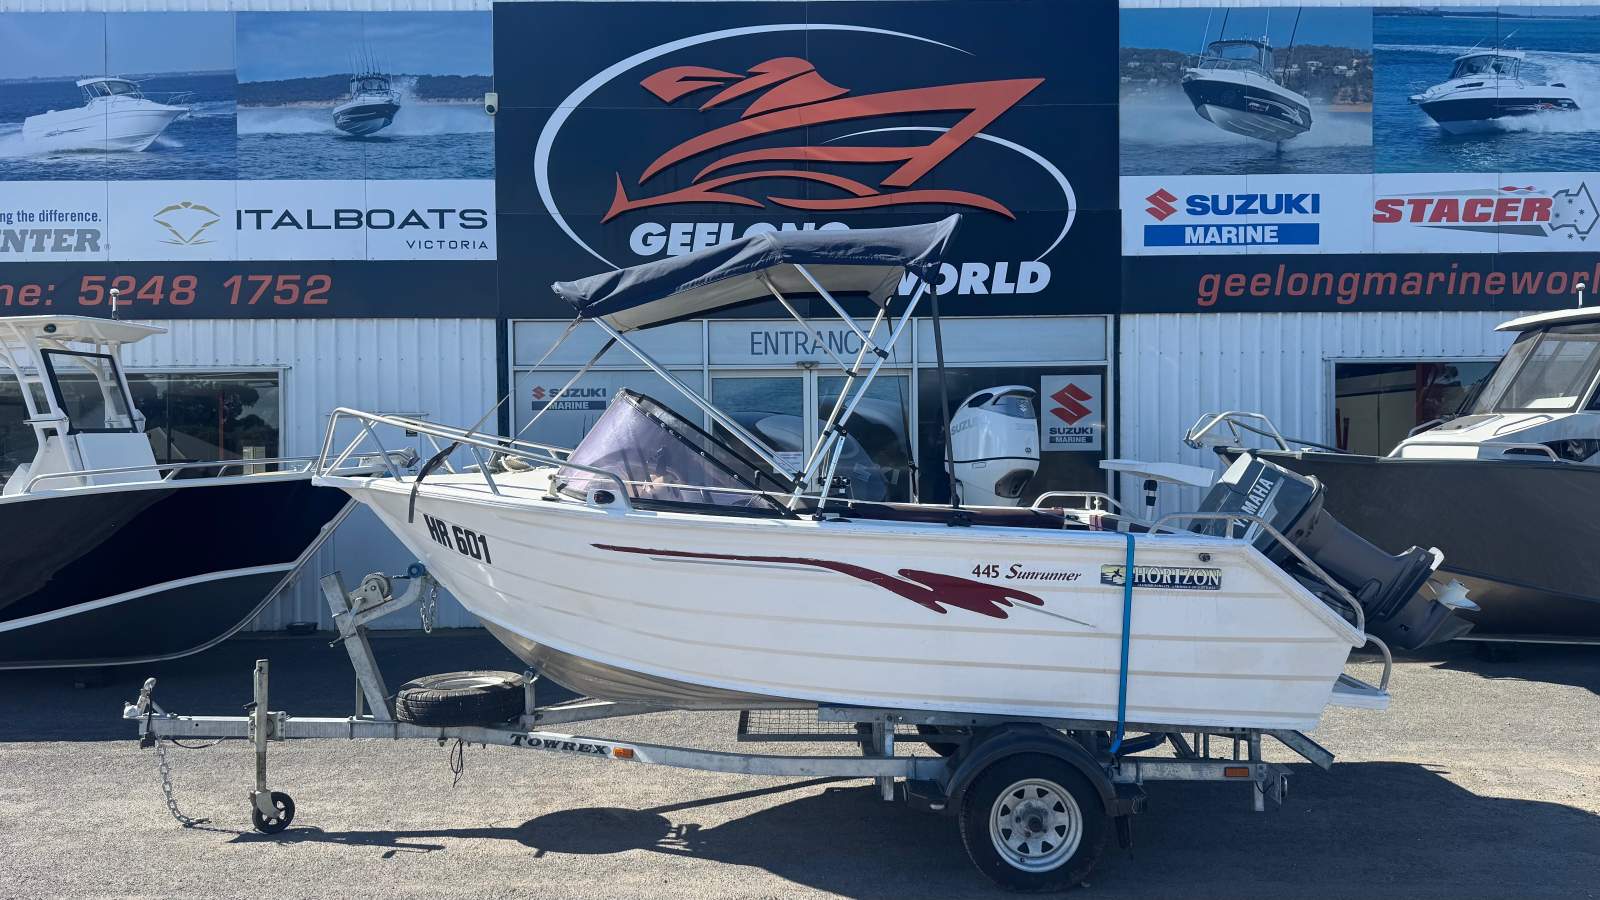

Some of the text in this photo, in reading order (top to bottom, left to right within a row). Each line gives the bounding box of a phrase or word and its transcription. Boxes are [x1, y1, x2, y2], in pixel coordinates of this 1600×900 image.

[1186, 193, 1320, 216] SUZUKI
[1372, 197, 1553, 224] STACER
[17, 210, 34, 222] the
[39, 209, 102, 222] difference.
[236, 208, 488, 230] ITALBOATS
[0, 228, 102, 252] NTER
[406, 240, 488, 249] VICTORIA
[1185, 226, 1279, 245] MARINE
[78, 274, 198, 306] 5248
[223, 274, 332, 305] 1752
[1197, 262, 1600, 306] geelongmarineworl
[549, 387, 606, 397] SUZUKI
[549, 401, 589, 409] MARINE
[1050, 427, 1093, 435] SUZUKI
[1233, 477, 1274, 528] YMAHA
[423, 513, 492, 565] HR 601
[972, 563, 1082, 581] 445 Sunrunner
[1134, 567, 1221, 586] HORIZON
